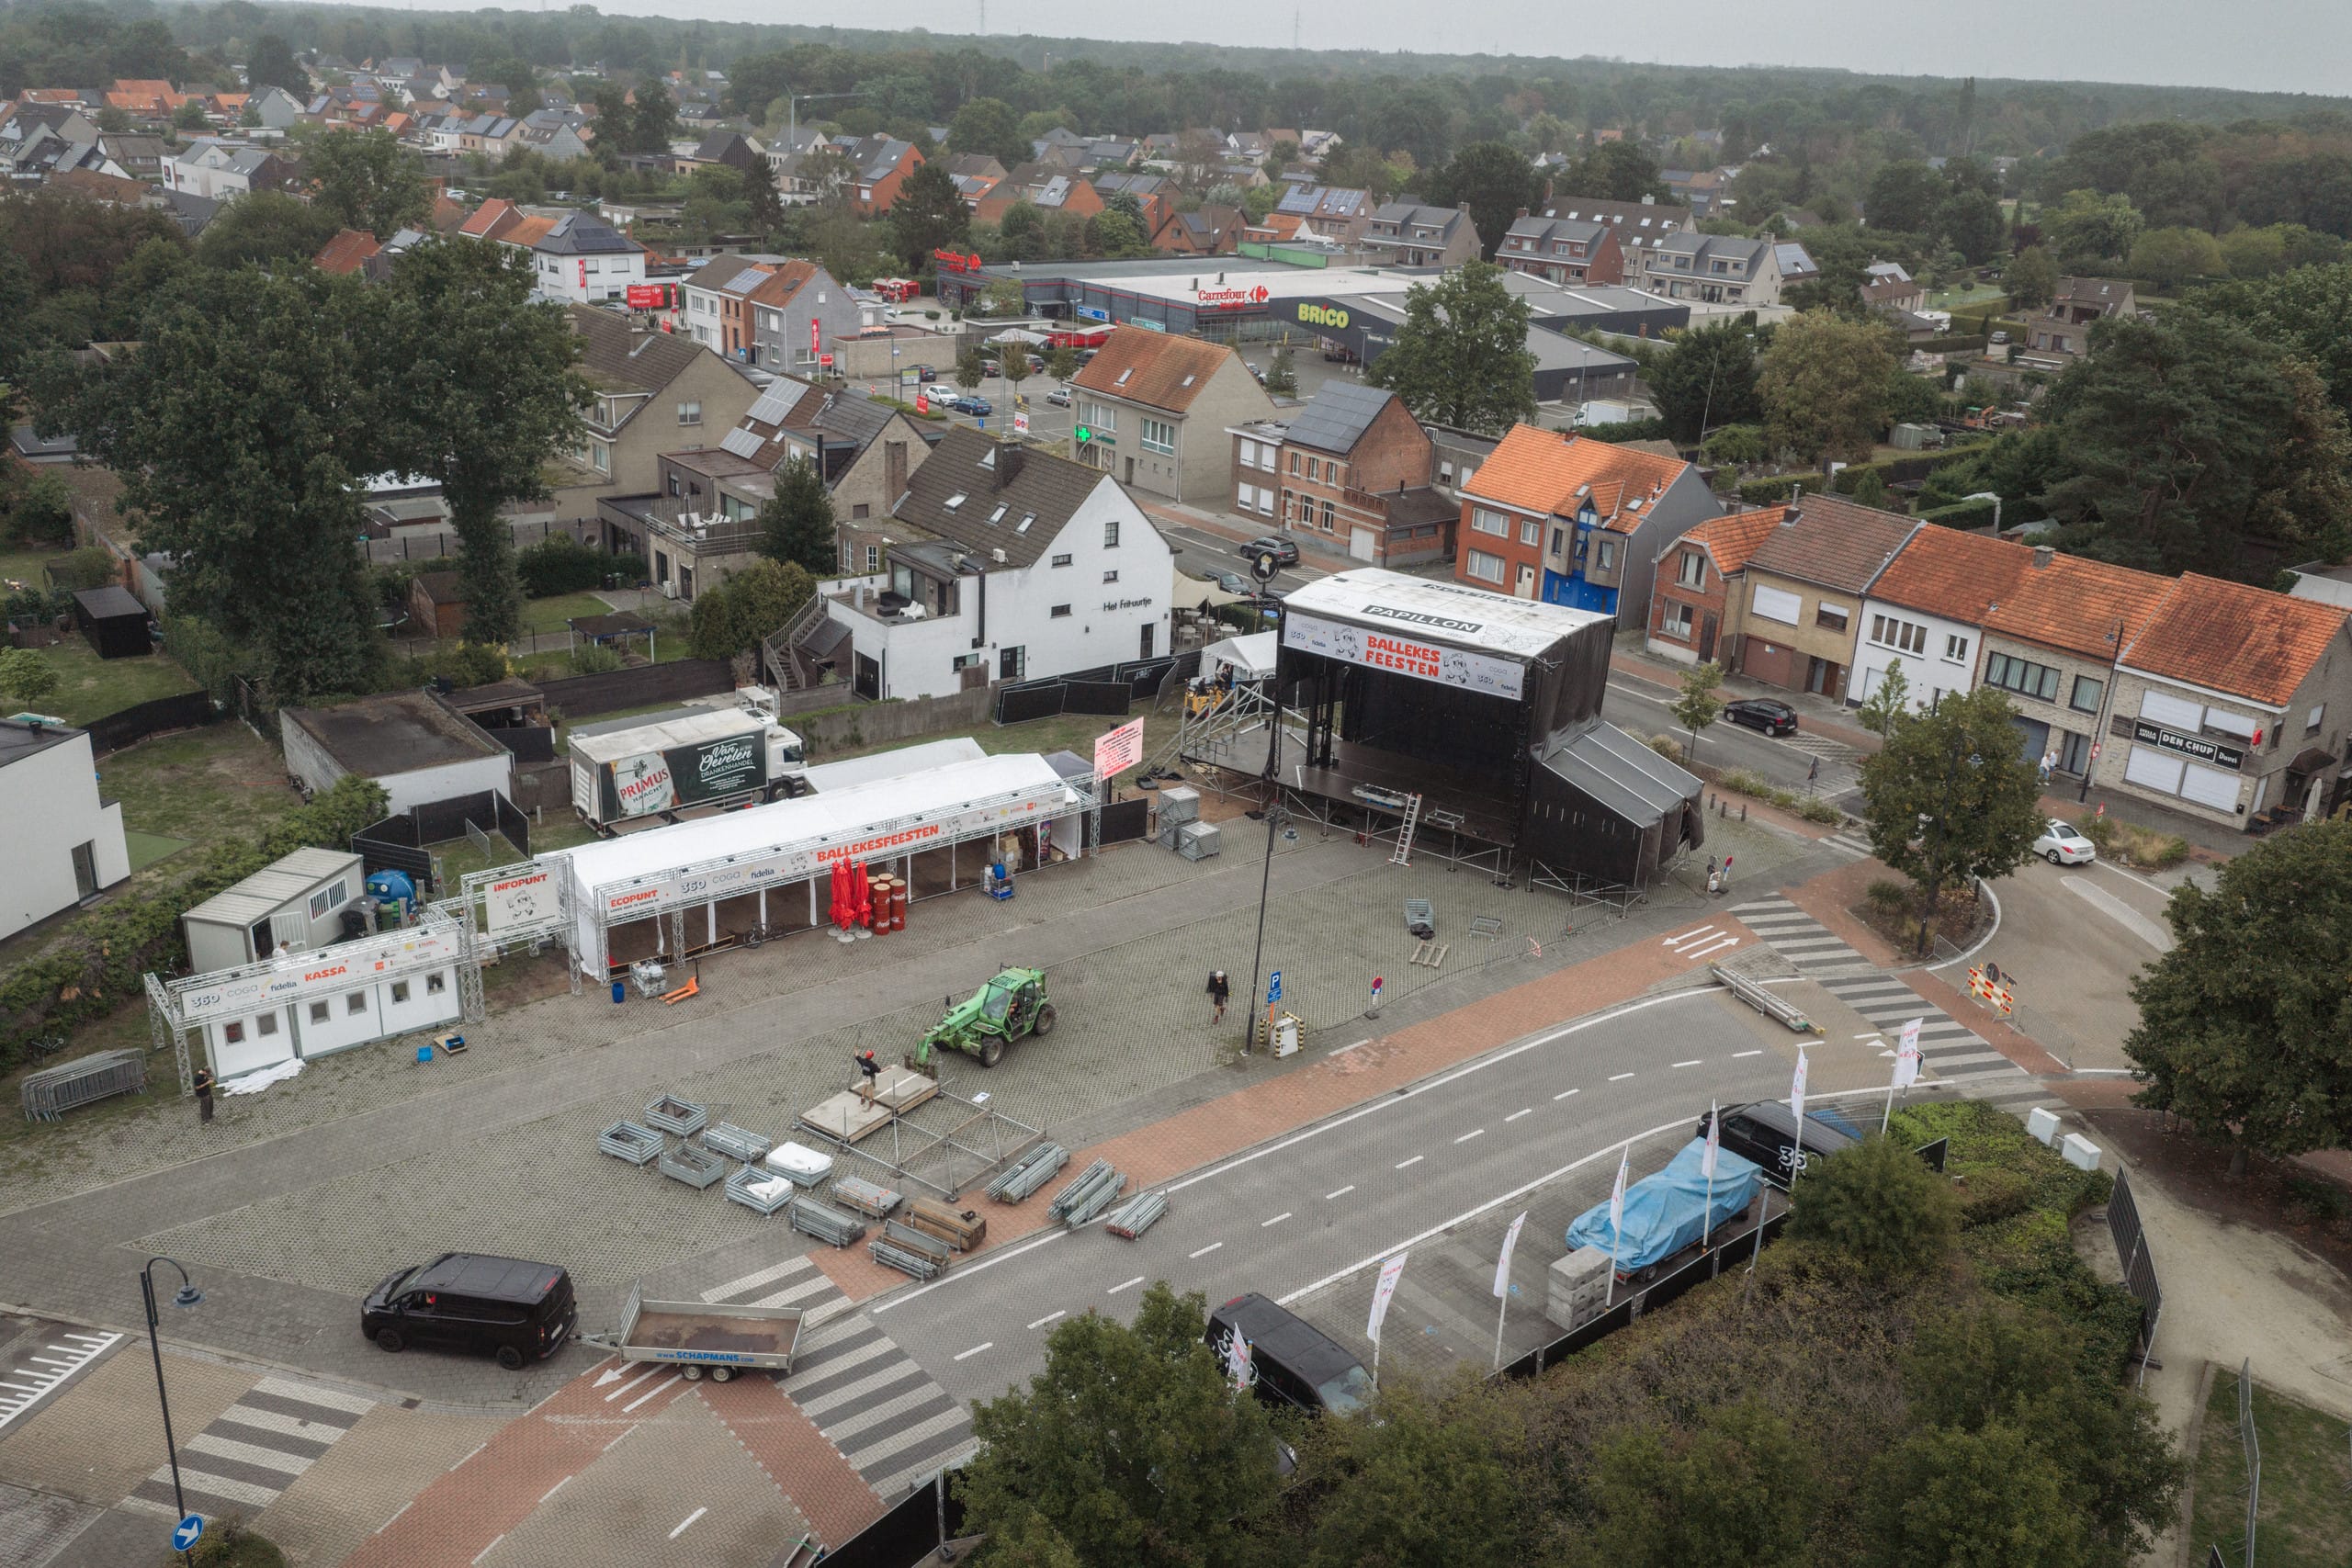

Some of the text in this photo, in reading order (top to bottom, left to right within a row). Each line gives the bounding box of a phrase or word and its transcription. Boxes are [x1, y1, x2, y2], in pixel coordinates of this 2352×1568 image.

[1198, 288, 1247, 300] Carrefour
[1103, 601, 1117, 611] Het
[1368, 606, 1477, 633] PAPILLON
[1367, 635, 1441, 663] BALLEKES
[1365, 649, 1440, 677] FEESTEN
[711, 742, 738, 757] Van
[2162, 734, 2184, 747] DEN
[2185, 740, 2214, 755] CHUP
[699, 749, 753, 772] Oevelen
[2218, 751, 2238, 764] Duvel
[701, 759, 754, 779] DRANKENHANDEL
[619, 768, 669, 800] PRIMUS
[632, 784, 663, 803] HAACHT
[817, 824, 939, 862] BALLEKESFEESTEN
[751, 868, 775, 879] fidelia
[493, 874, 548, 892] INFOPUNT
[681, 879, 707, 894] 360
[610, 889, 658, 908] ECOPUNT
[304, 965, 346, 981] KASSA
[1272, 975, 1280, 988] P
[270, 980, 298, 992] fidelia
[191, 995, 220, 1008] 360
[676, 1351, 741, 1362] SCHAPMANS
